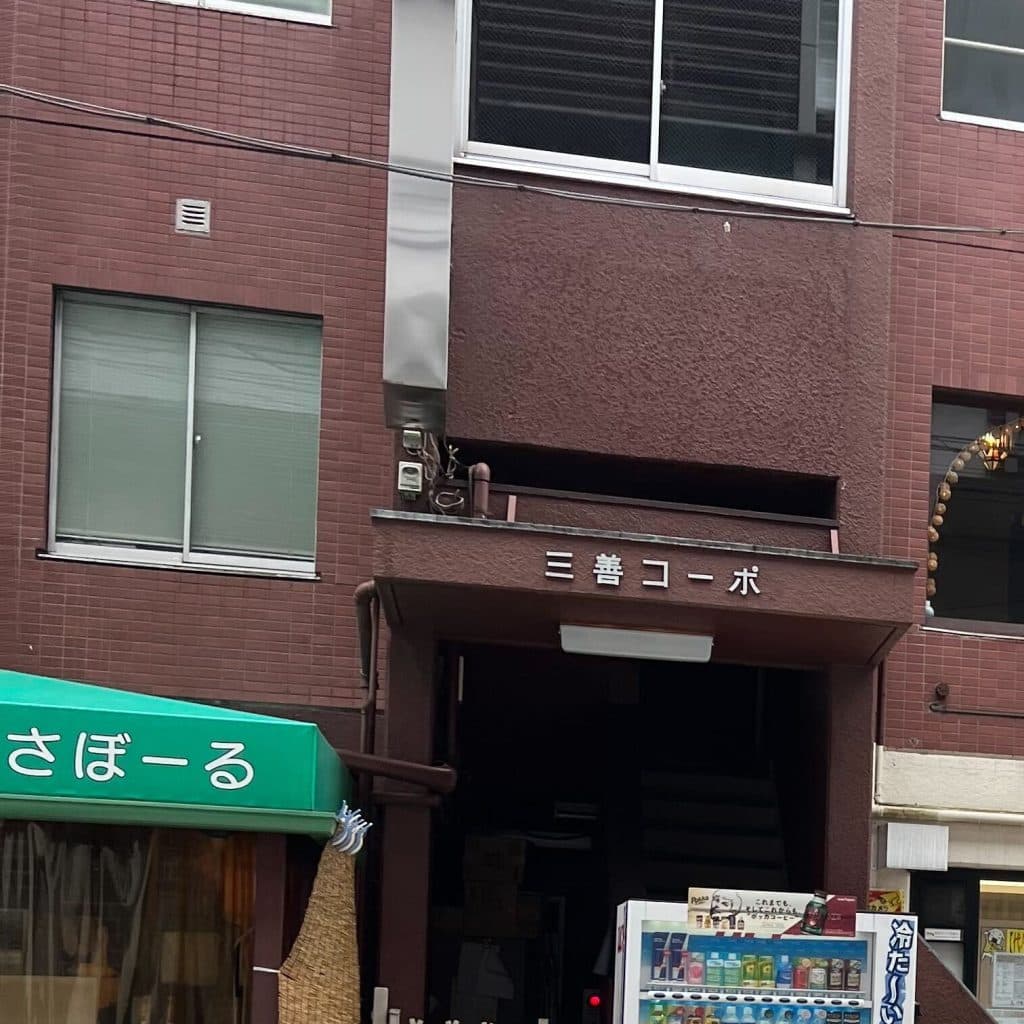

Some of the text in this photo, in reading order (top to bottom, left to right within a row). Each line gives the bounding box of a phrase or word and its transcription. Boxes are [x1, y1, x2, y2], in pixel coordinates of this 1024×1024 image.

[545, 551, 761, 595] 三善コーポ
[7, 727, 254, 790] さぼーる
